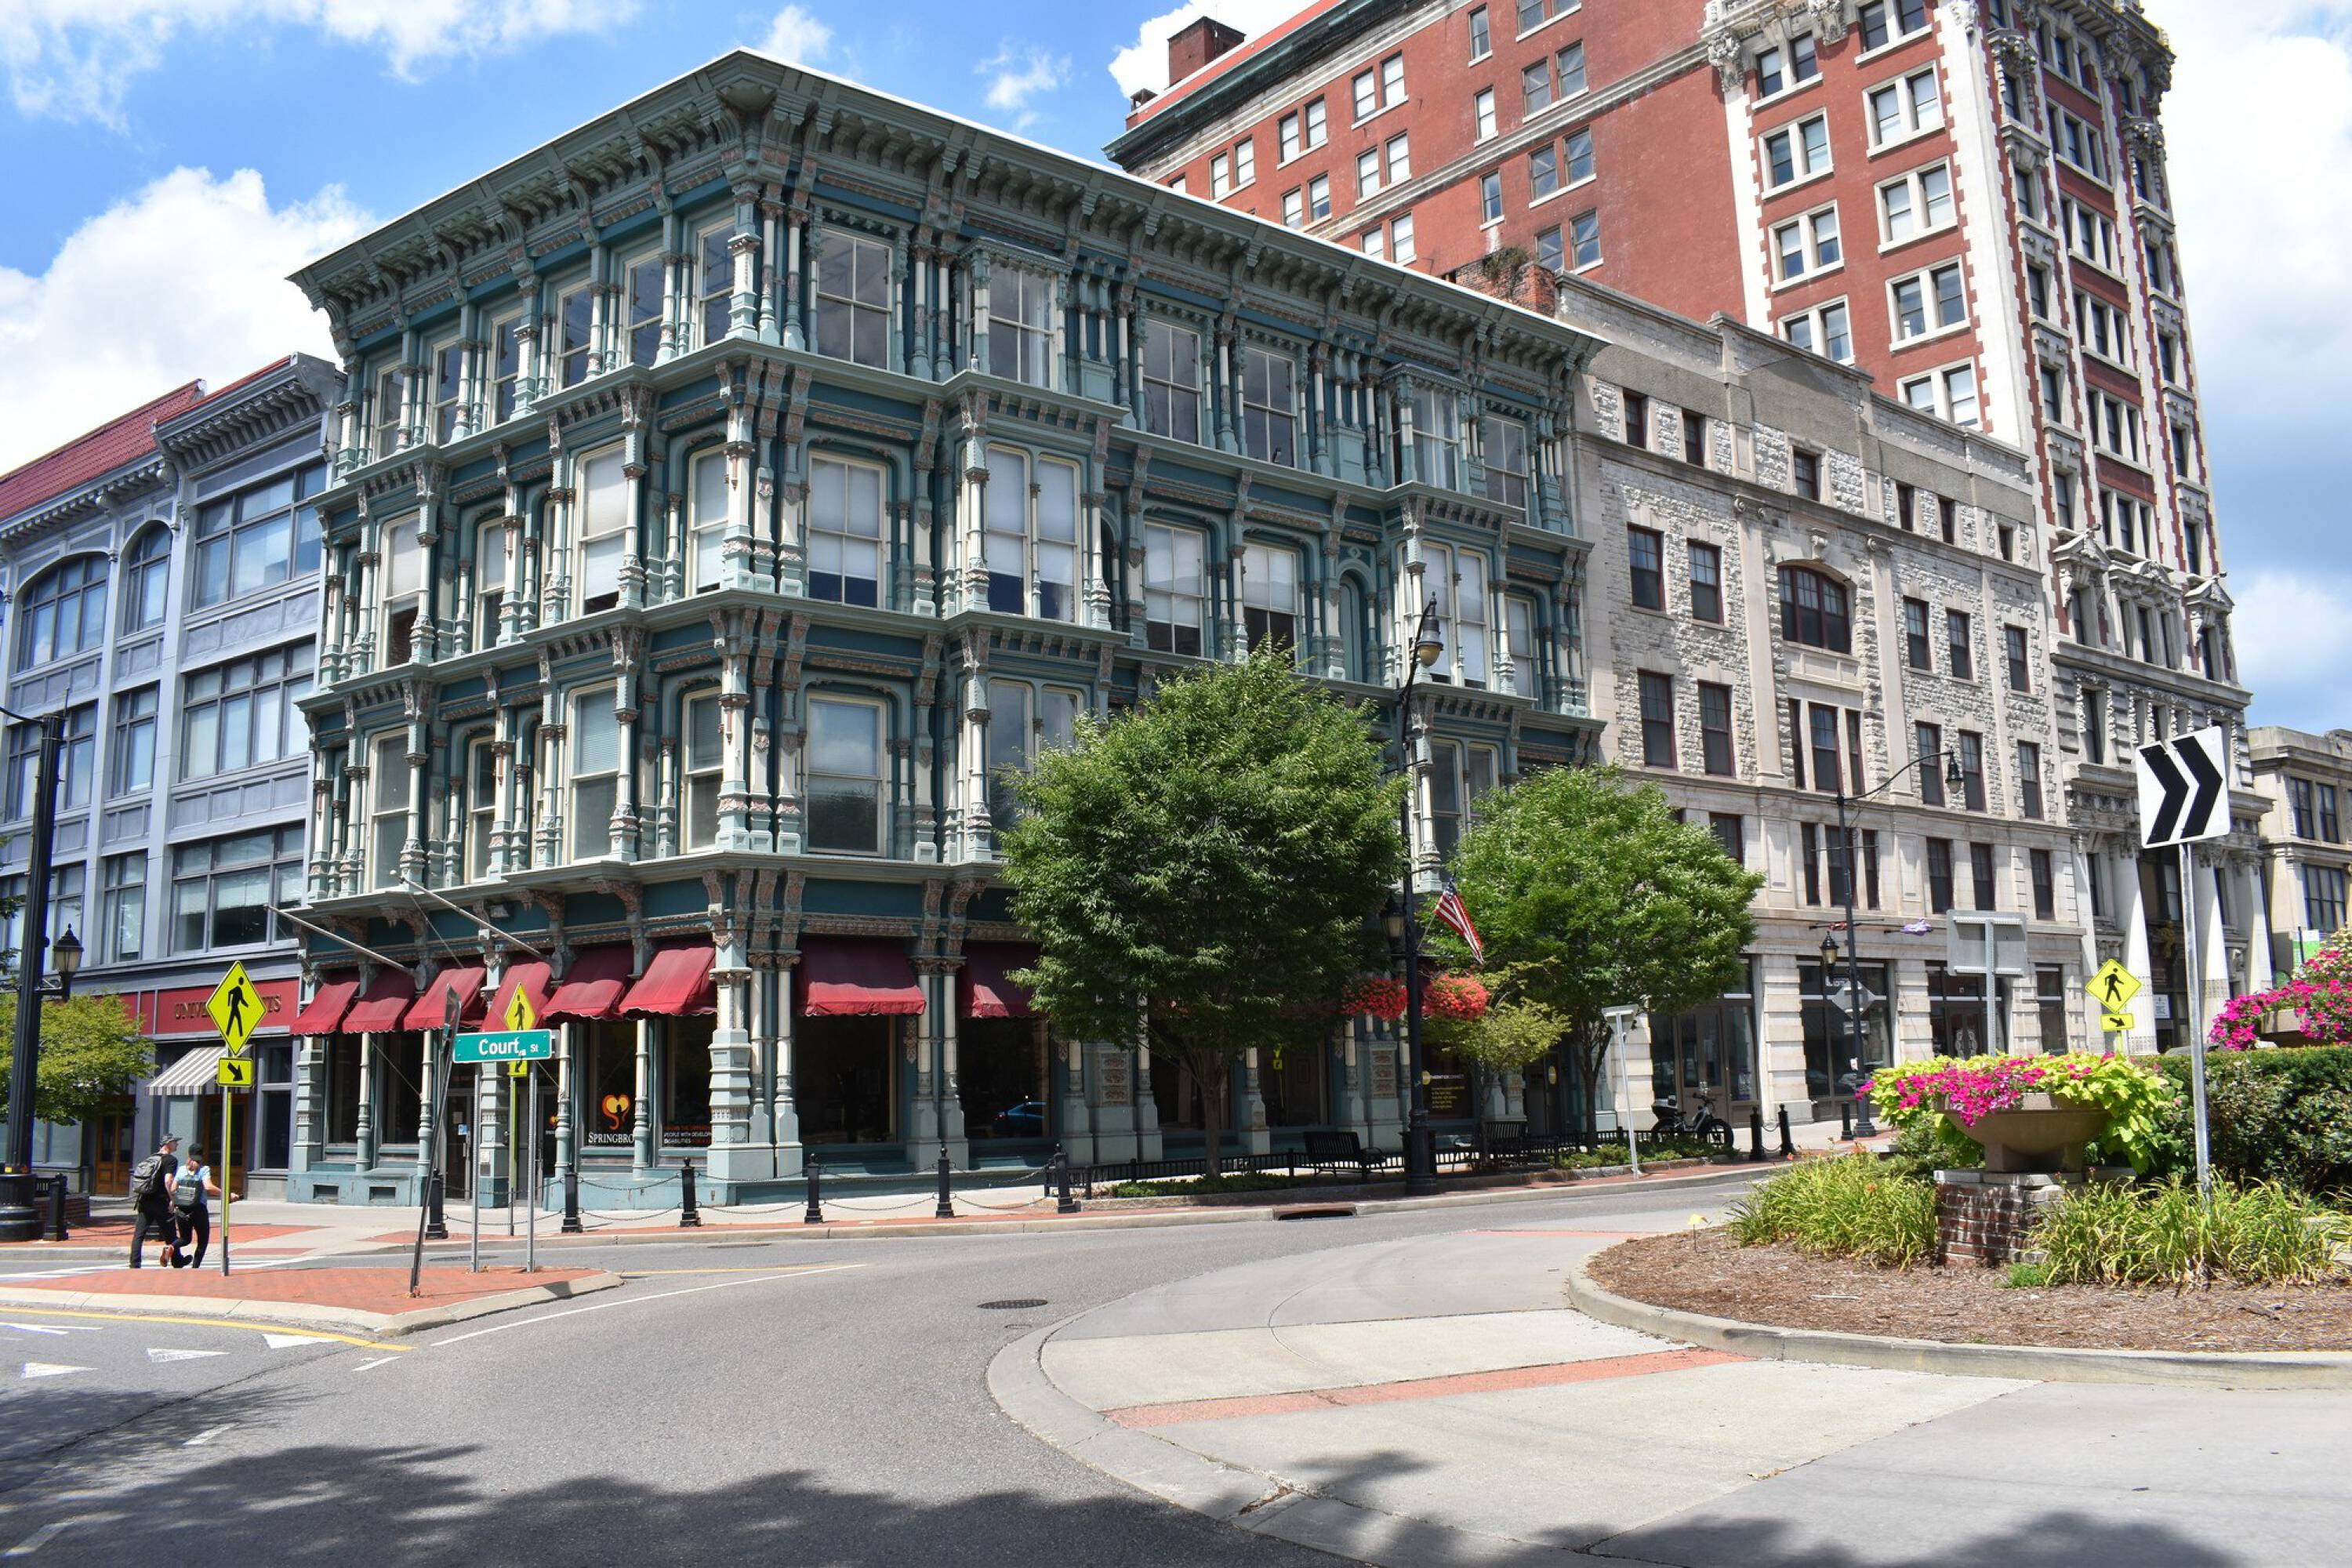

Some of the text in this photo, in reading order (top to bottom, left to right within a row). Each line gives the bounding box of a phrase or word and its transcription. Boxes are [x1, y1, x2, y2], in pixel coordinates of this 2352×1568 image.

[175, 1002, 209, 1019] UNIVE
[479, 1037, 539, 1055] Court St
[588, 1132, 633, 1143] SPRINGBRO
